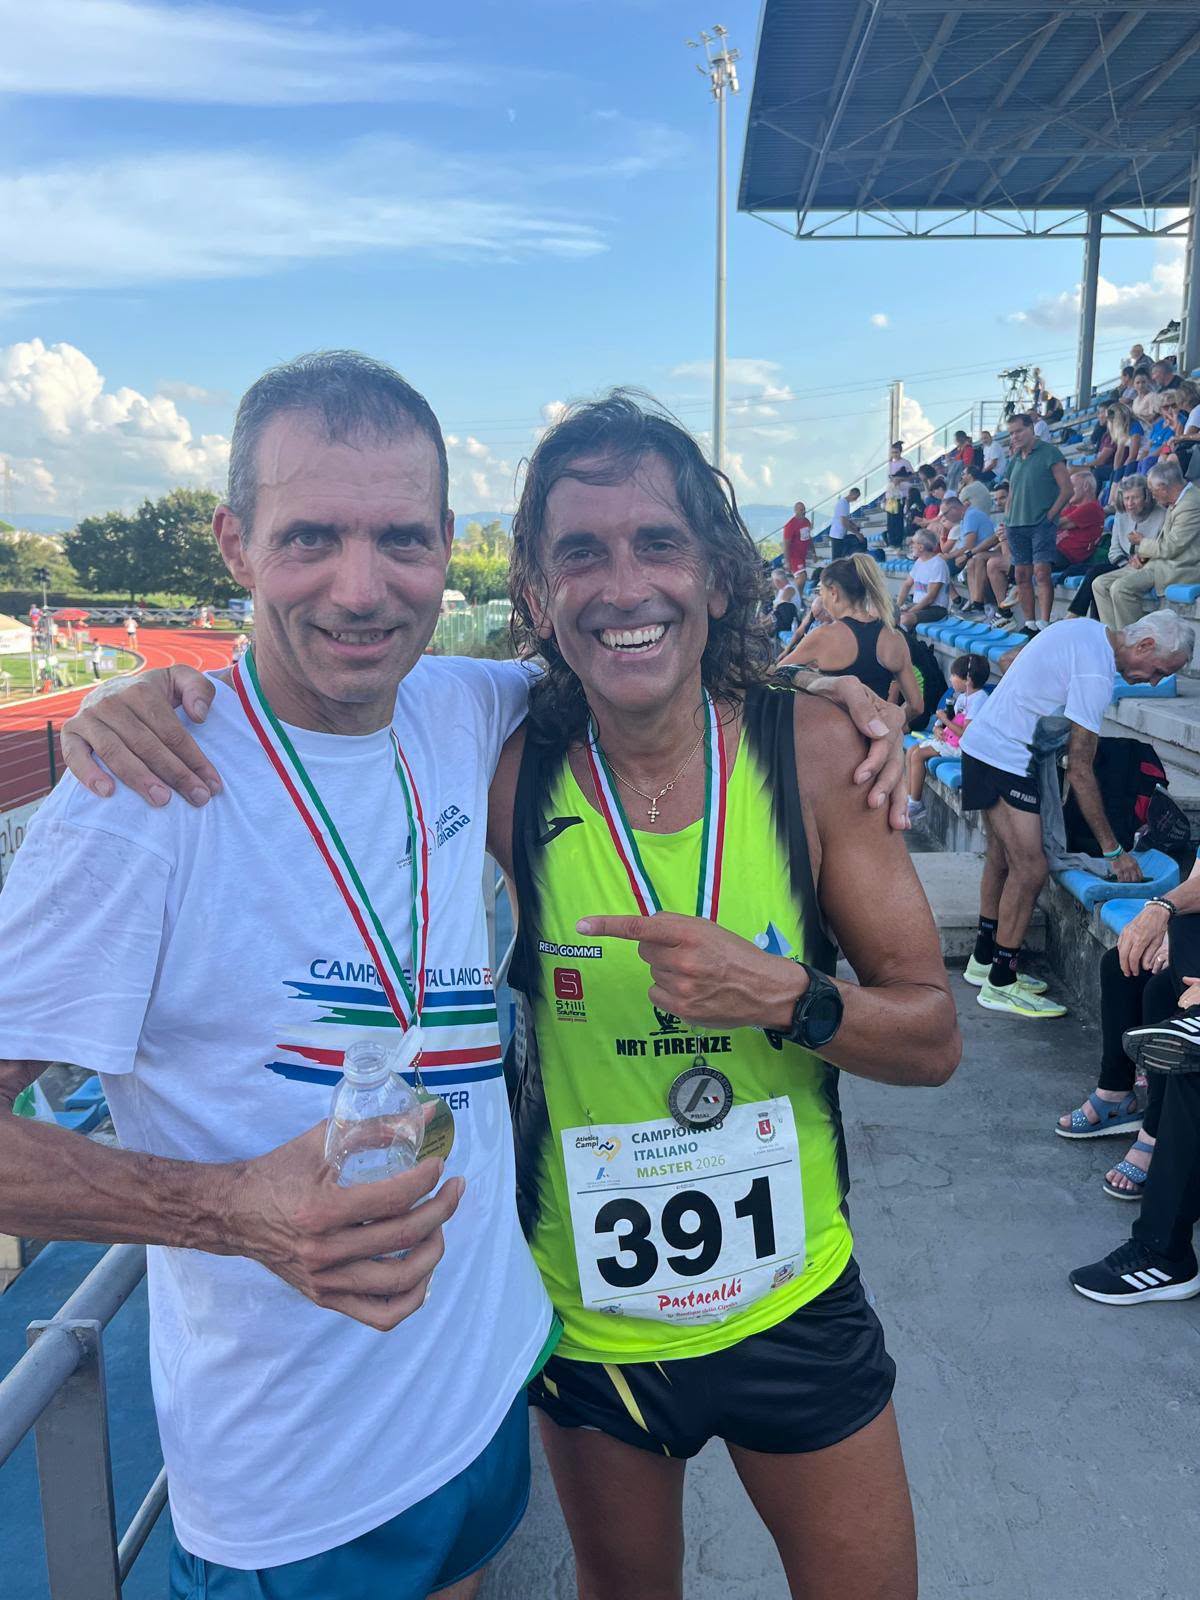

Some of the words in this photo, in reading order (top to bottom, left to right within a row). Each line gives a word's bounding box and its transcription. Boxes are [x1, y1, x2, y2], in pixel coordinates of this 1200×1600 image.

[539, 941, 558, 953] REDI
[560, 945, 602, 957] GOMME
[310, 959, 412, 987] CAMPIE
[424, 967, 481, 988] TALIANO
[556, 999, 585, 1011] Stilli
[616, 1039, 647, 1056] NRT
[654, 1036, 732, 1057] FIRENZE
[438, 1091, 469, 1110] TER
[575, 1140, 599, 1149] Campi
[634, 1141, 698, 1161] ITALIANO
[636, 1160, 693, 1178] MASTER
[695, 1154, 726, 1170] 2026
[594, 1175, 776, 1288] 391
[657, 1278, 742, 1311] Pastacaldi
